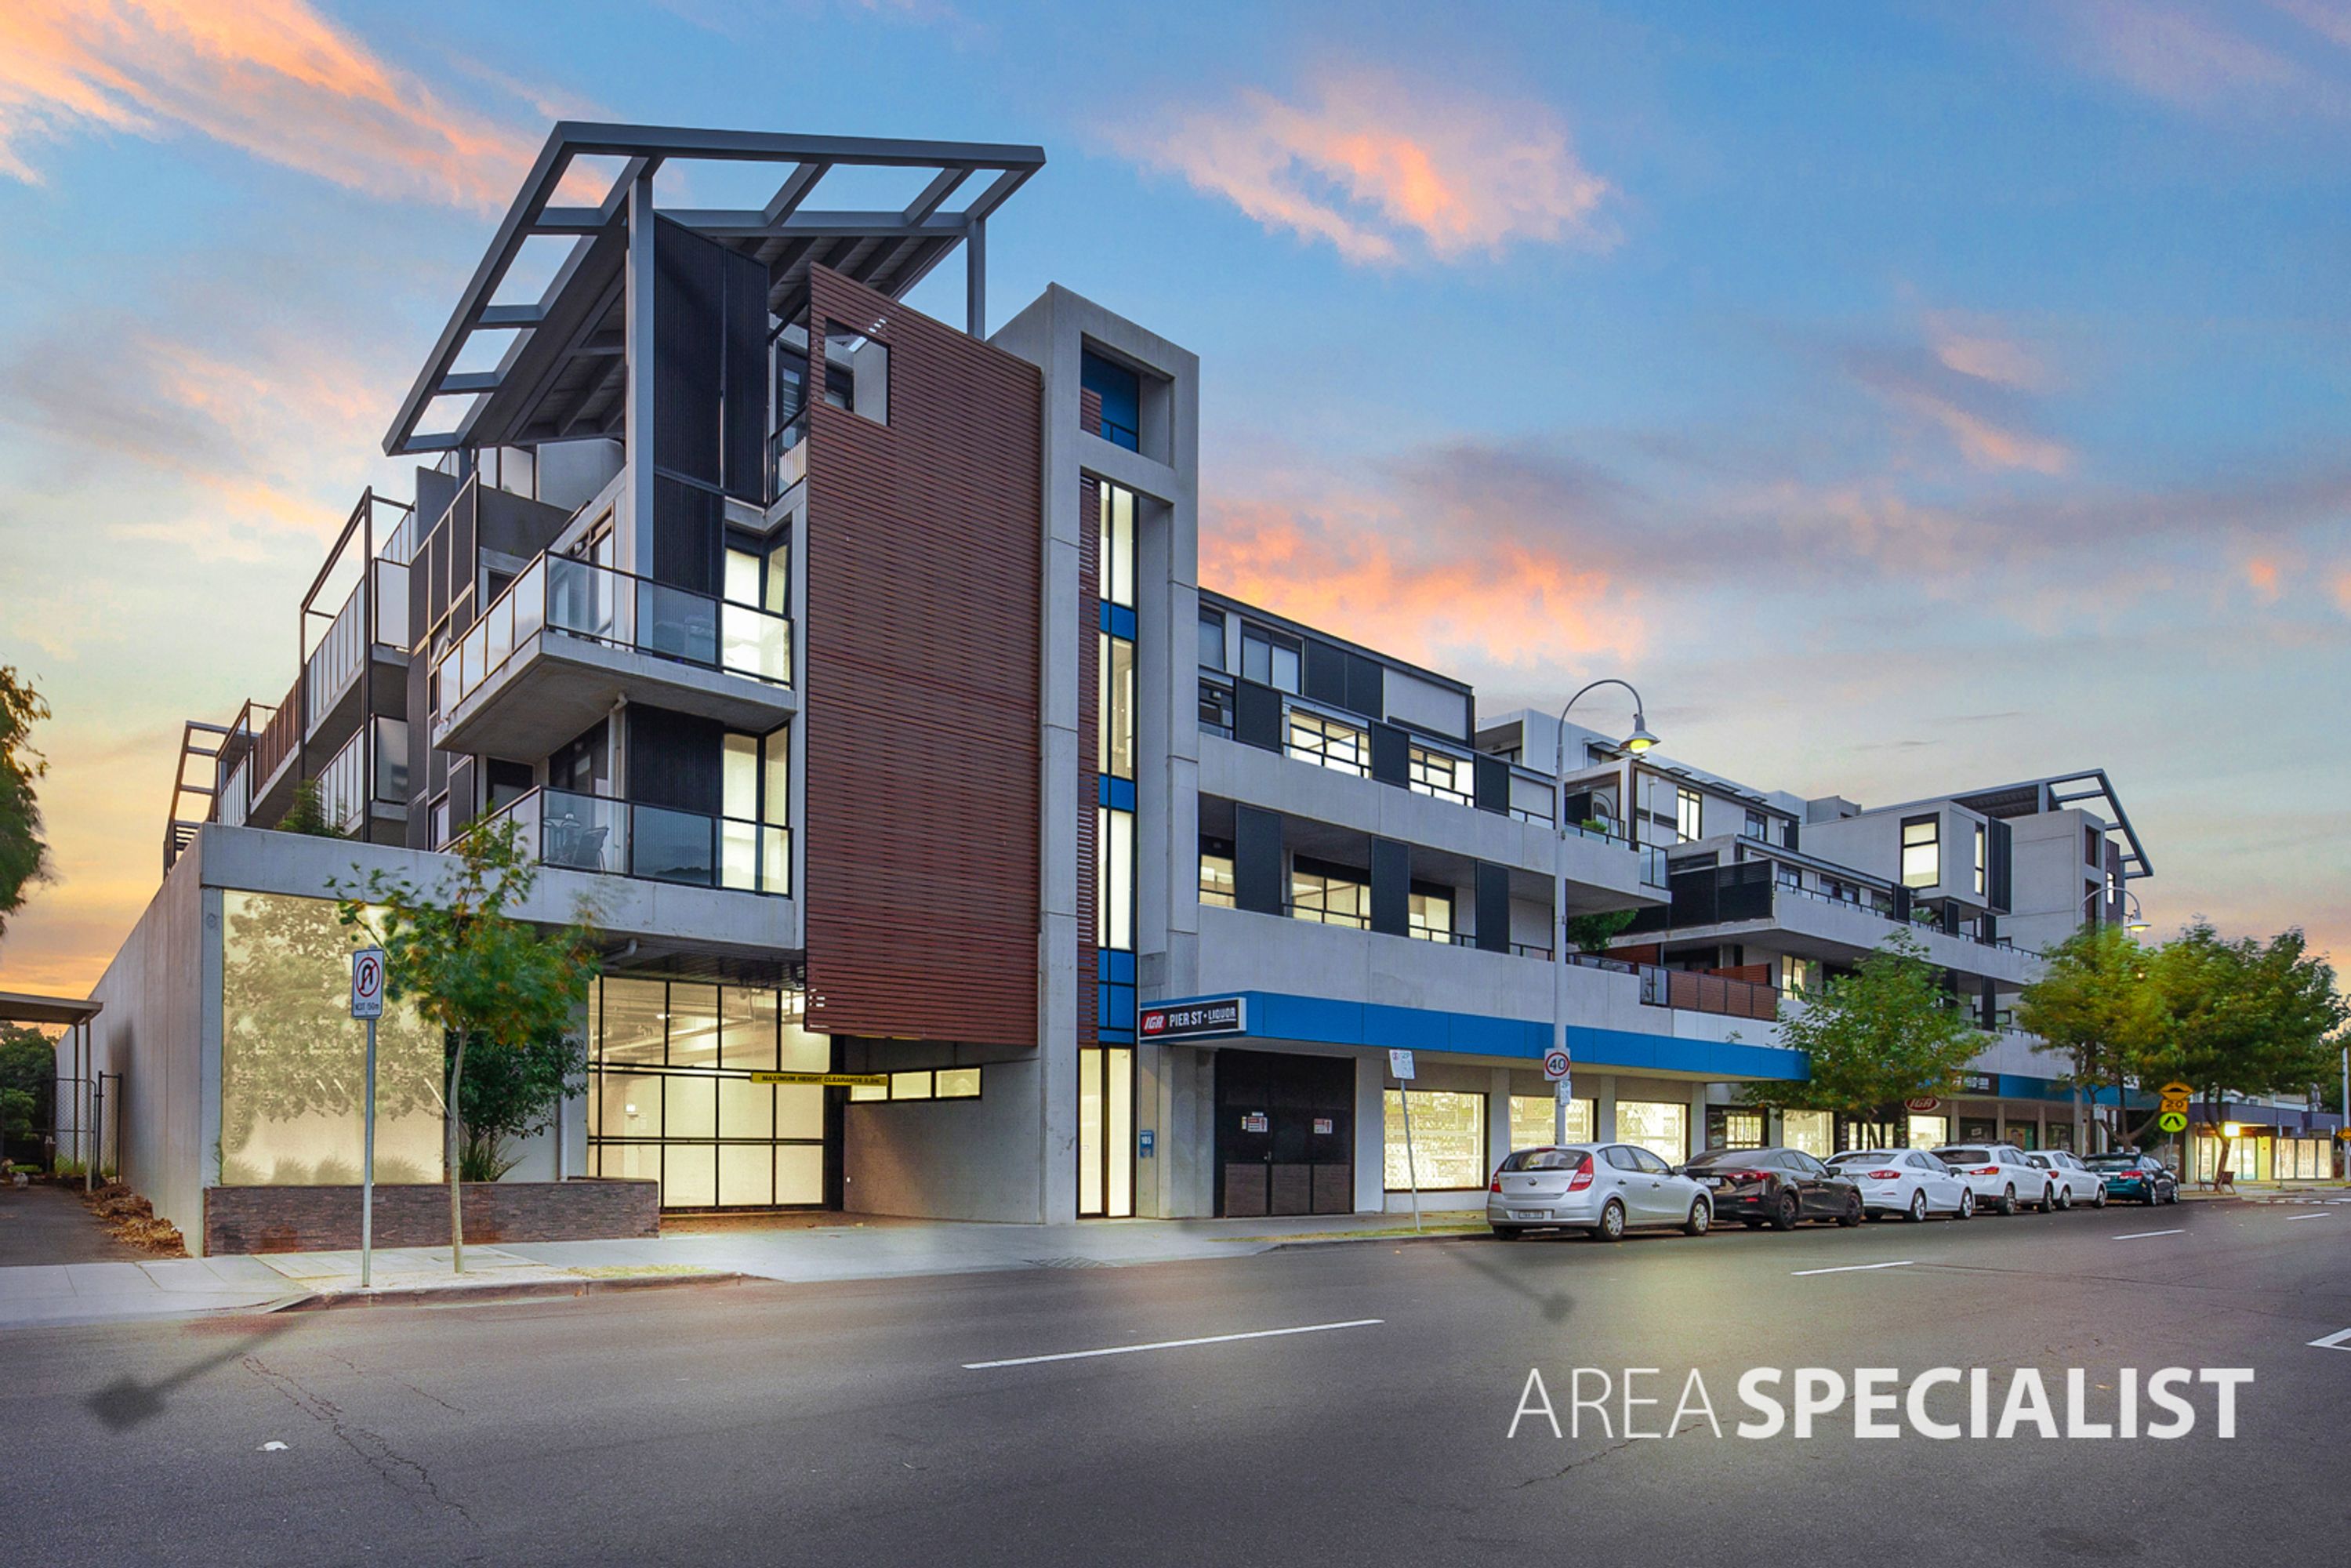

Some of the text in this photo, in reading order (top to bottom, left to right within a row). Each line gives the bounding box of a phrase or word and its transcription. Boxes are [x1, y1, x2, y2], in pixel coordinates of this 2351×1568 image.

[1145, 1007, 1235, 1030] IGA PIER ST LIQUOR
[1549, 1058, 1566, 1070] 40
[1910, 1098, 1933, 1107] IGA
[2166, 1100, 2183, 1109] 20
